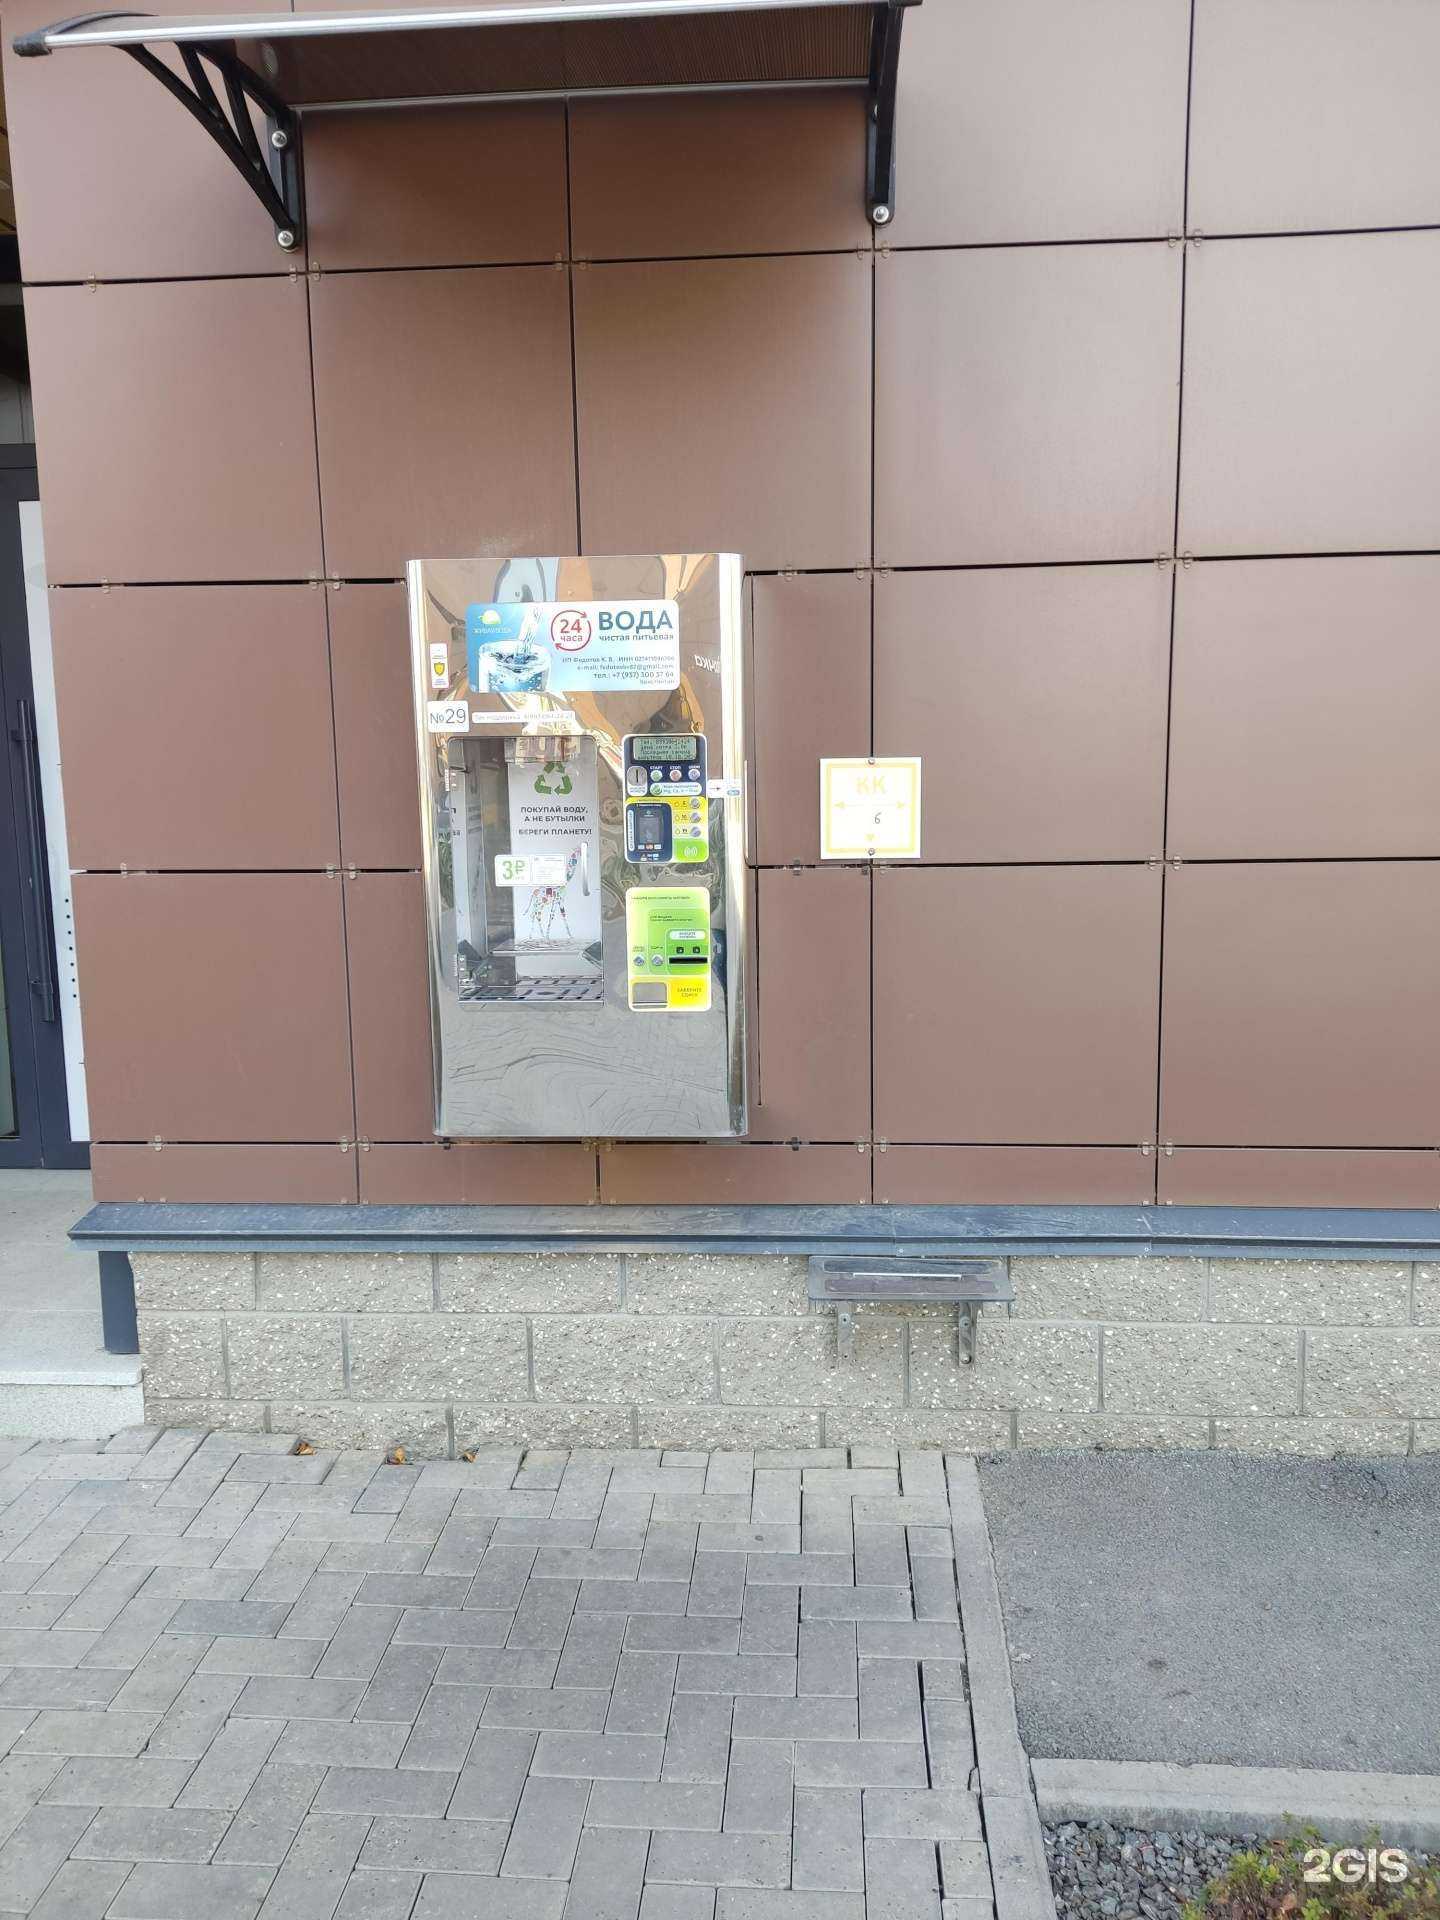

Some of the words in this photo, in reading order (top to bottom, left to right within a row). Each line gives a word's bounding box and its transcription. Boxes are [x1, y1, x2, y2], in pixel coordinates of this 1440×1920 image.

[560, 618, 582, 634] 24
[598, 609, 673, 634] ВОДА
[560, 634, 583, 642] часа
[622, 671, 640, 679] (937)
[856, 776, 886, 794] КК
[520, 805, 561, 813] ПОКУПАЙ
[563, 806, 588, 814] ВОДУ,
[874, 812, 882, 824] 6
[551, 828, 592, 836] ПЛАНЕТУ!
